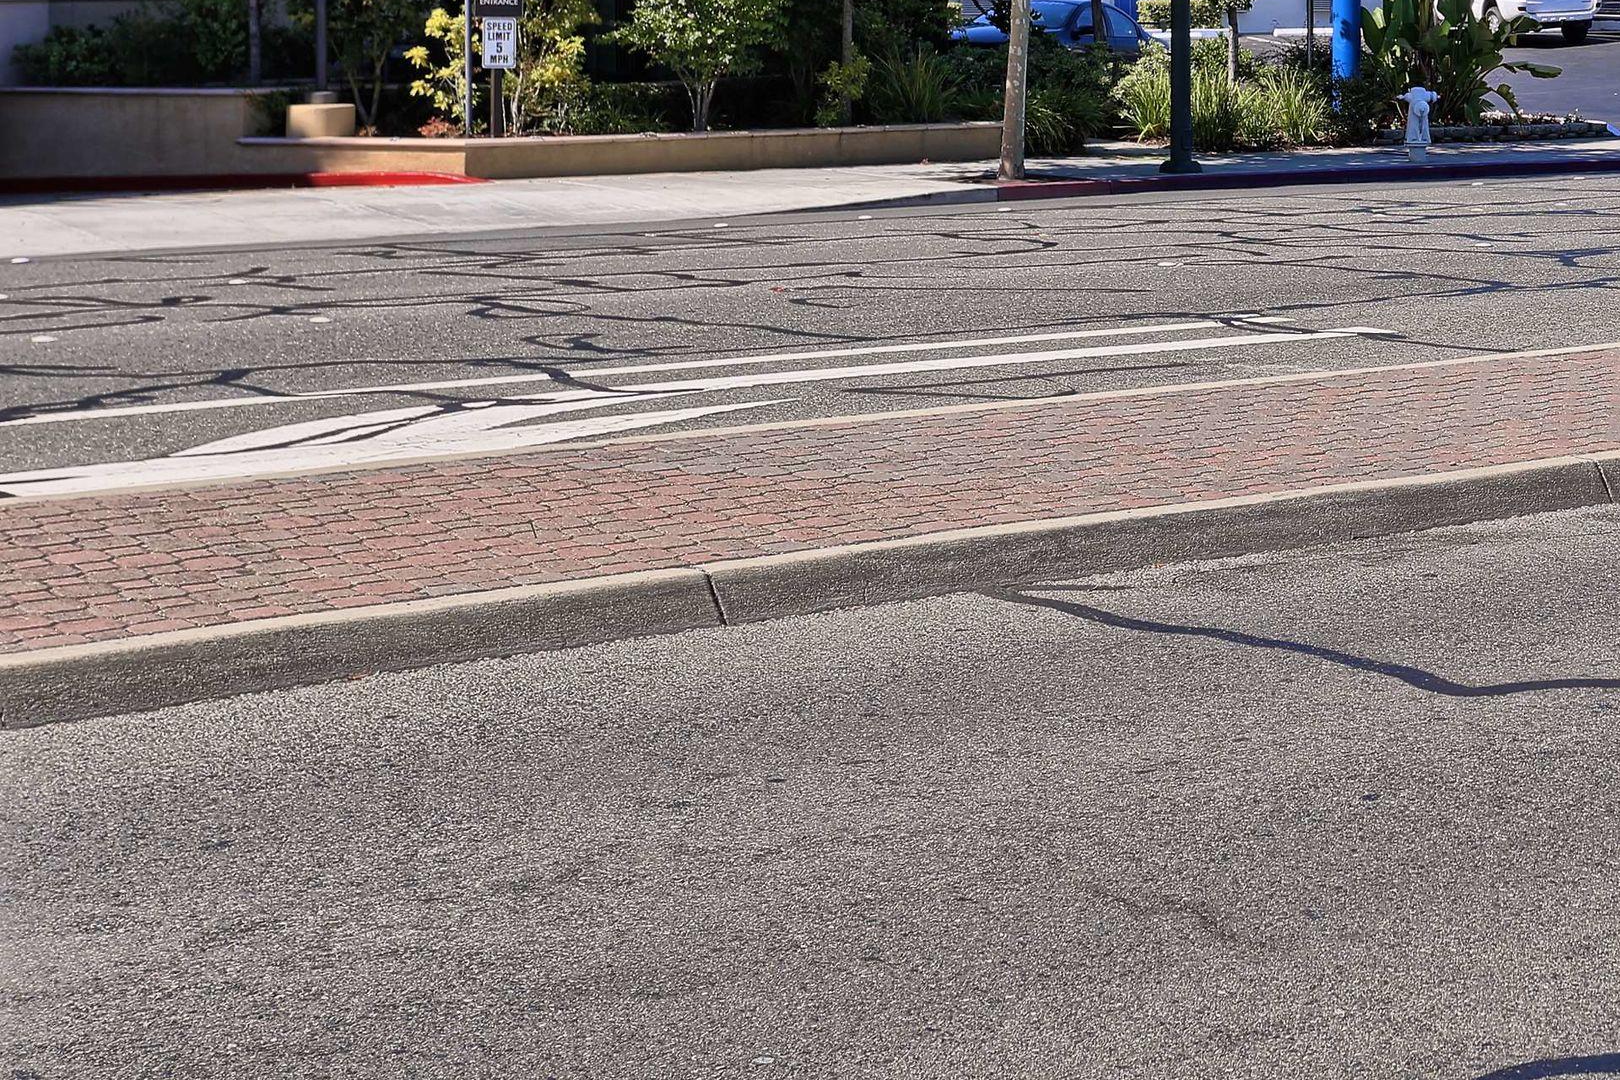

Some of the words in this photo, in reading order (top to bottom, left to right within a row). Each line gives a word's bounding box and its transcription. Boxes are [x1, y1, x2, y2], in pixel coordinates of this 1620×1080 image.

[486, 22, 513, 31] SPEED
[487, 31, 511, 41] LIMIT
[496, 41, 503, 54] 5
[489, 54, 509, 64] MPH
